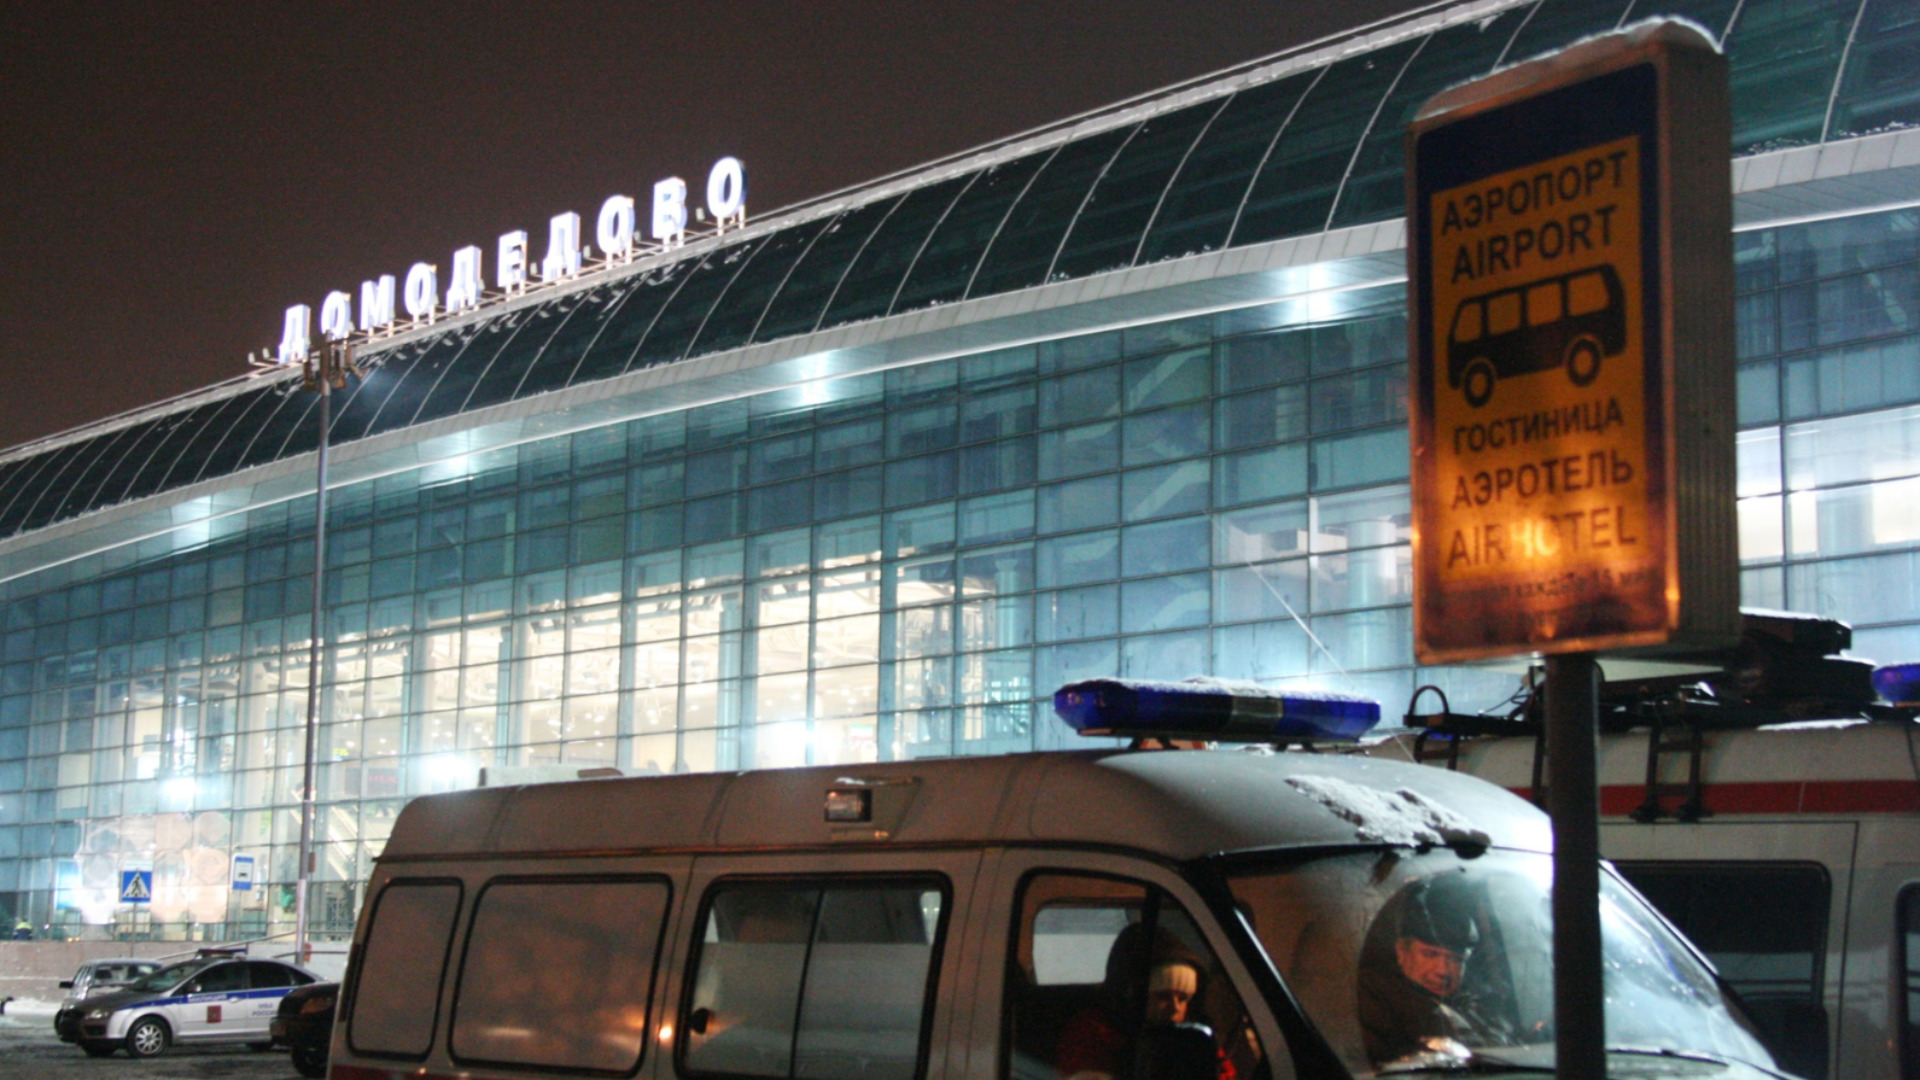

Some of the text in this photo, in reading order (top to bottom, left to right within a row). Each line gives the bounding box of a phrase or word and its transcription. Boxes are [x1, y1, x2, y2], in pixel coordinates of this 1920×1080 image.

[1441, 150, 1628, 237] АЭРОПОРТ
[278, 156, 748, 366] ДОМОДЕДОВО
[1451, 205, 1618, 285] AIRPORT
[1453, 396, 1625, 456] ГОСТИНИЦА
[1450, 449, 1633, 512] АЭРОТЕЛЬ
